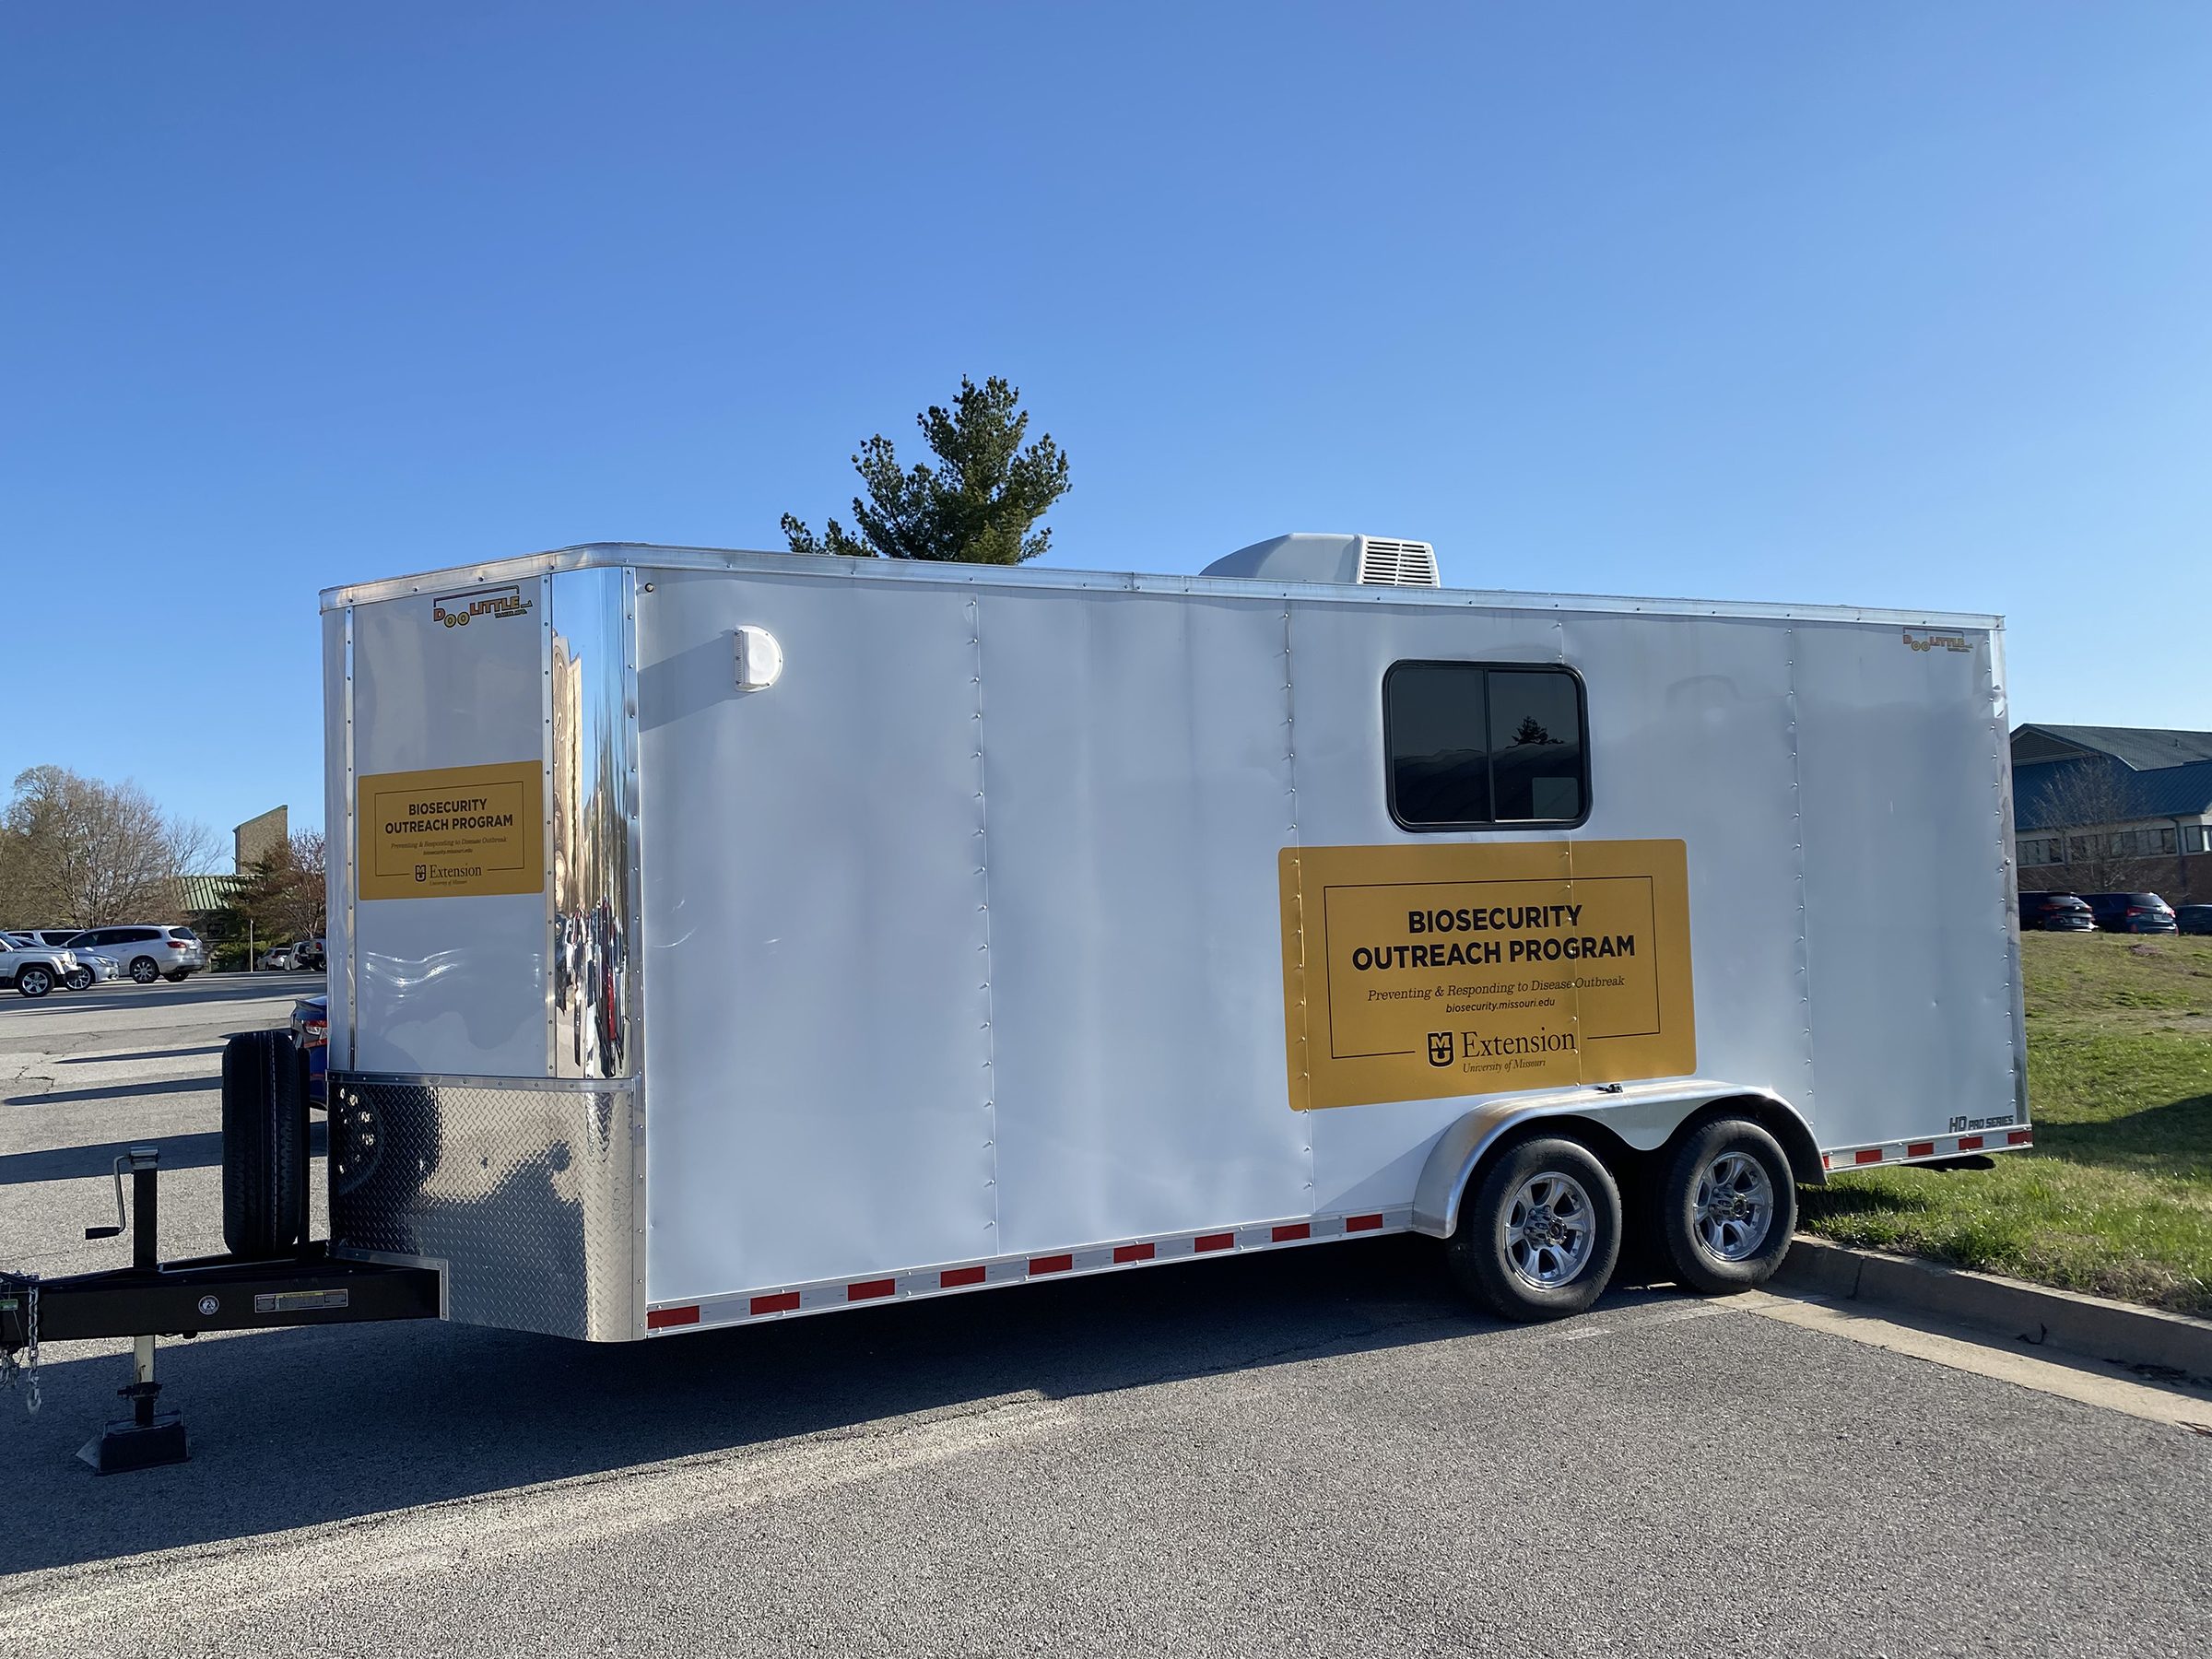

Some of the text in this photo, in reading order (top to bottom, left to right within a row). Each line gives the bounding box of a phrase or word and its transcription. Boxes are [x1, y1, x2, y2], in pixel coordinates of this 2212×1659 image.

[433, 595, 520, 628] DOOLITTLE
[1903, 634, 1965, 652] DOOLITTLE
[408, 798, 488, 816] BIOSECURITY
[384, 814, 513, 834] OUTREACH PROGRAM
[391, 841, 418, 849] Preventing
[424, 839, 454, 848] Responding
[462, 837, 481, 845] Disease
[429, 863, 482, 878] Extension
[1408, 904, 1583, 934] BIOSECURITY
[1352, 935, 1635, 971] OUTREACH PROGRAM
[1368, 975, 1625, 1001] Preventing & Responding to Disease Outbreak
[1445, 997, 1556, 1013] biosecurity.missouri.edu
[1461, 1026, 1577, 1058] Extension
[1463, 1057, 1547, 1074] University of Missouri
[1949, 1115, 2014, 1133] HD PRO SERIES
